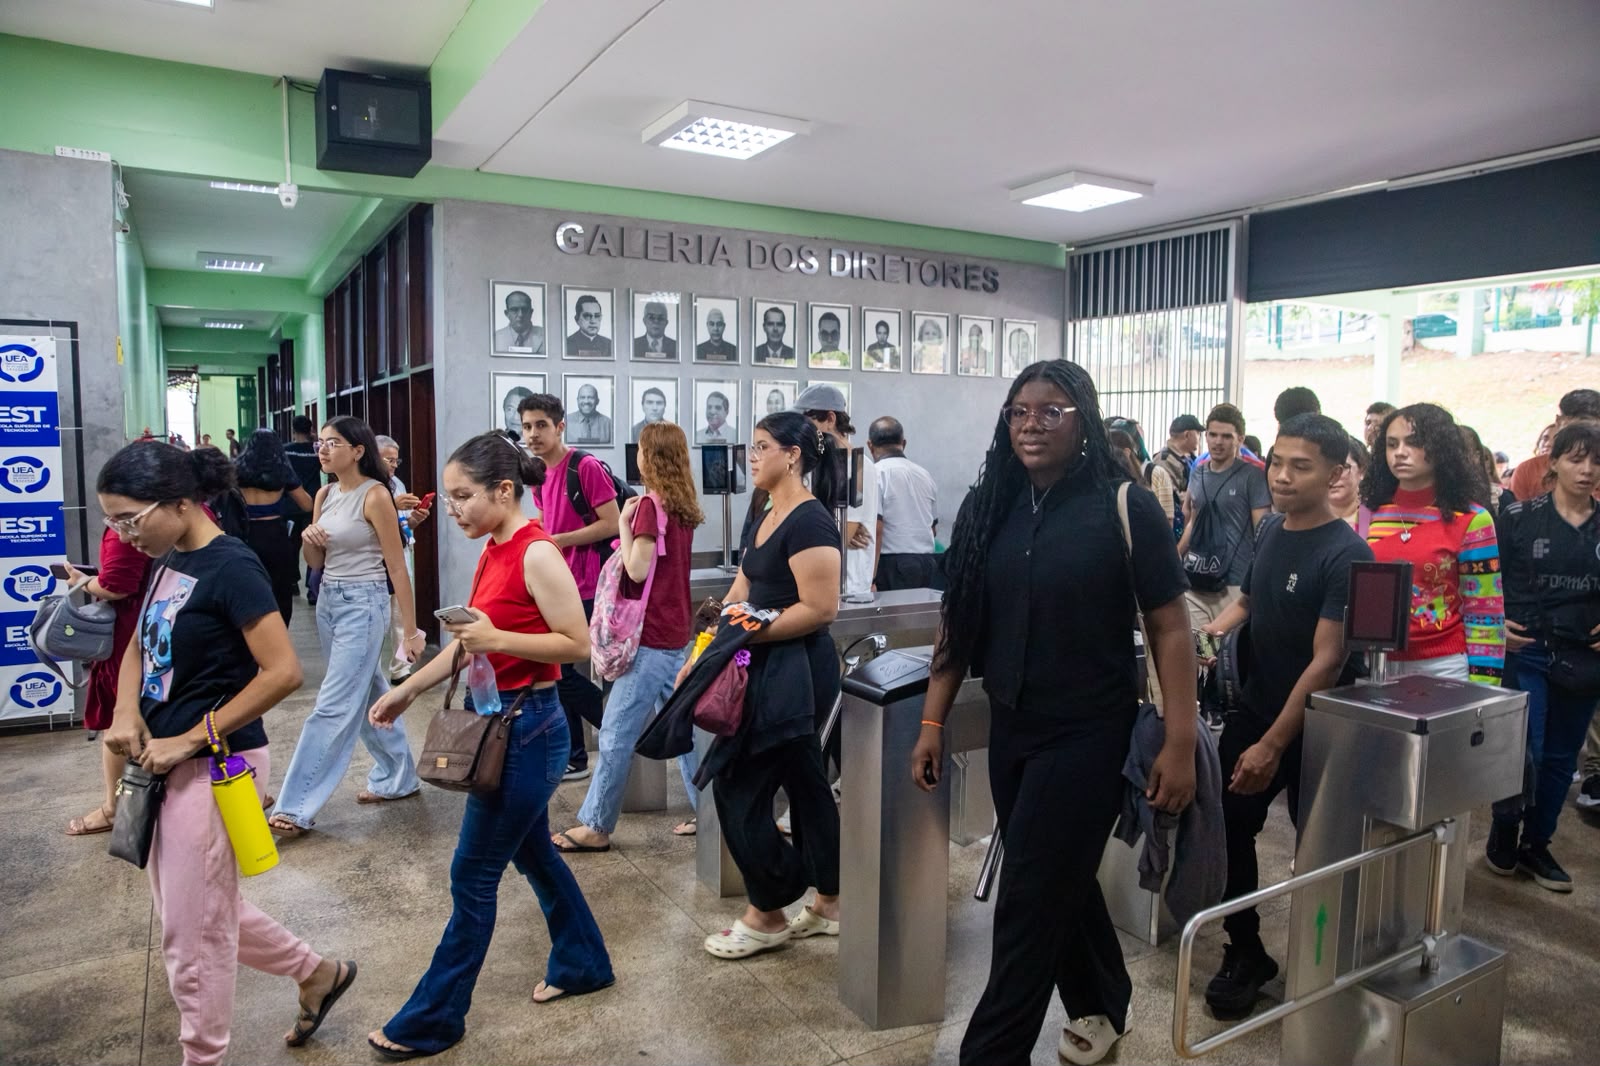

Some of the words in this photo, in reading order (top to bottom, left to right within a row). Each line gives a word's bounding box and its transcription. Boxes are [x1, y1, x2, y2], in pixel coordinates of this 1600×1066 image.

[555, 221, 735, 267] GALERIA
[746, 239, 819, 275] DOS
[829, 248, 1000, 293] DIRETORES
[0, 406, 47, 423] EST
[0, 516, 53, 534] EST
[1183, 551, 1221, 574] FILA
[25, 682, 47, 690] UEA
